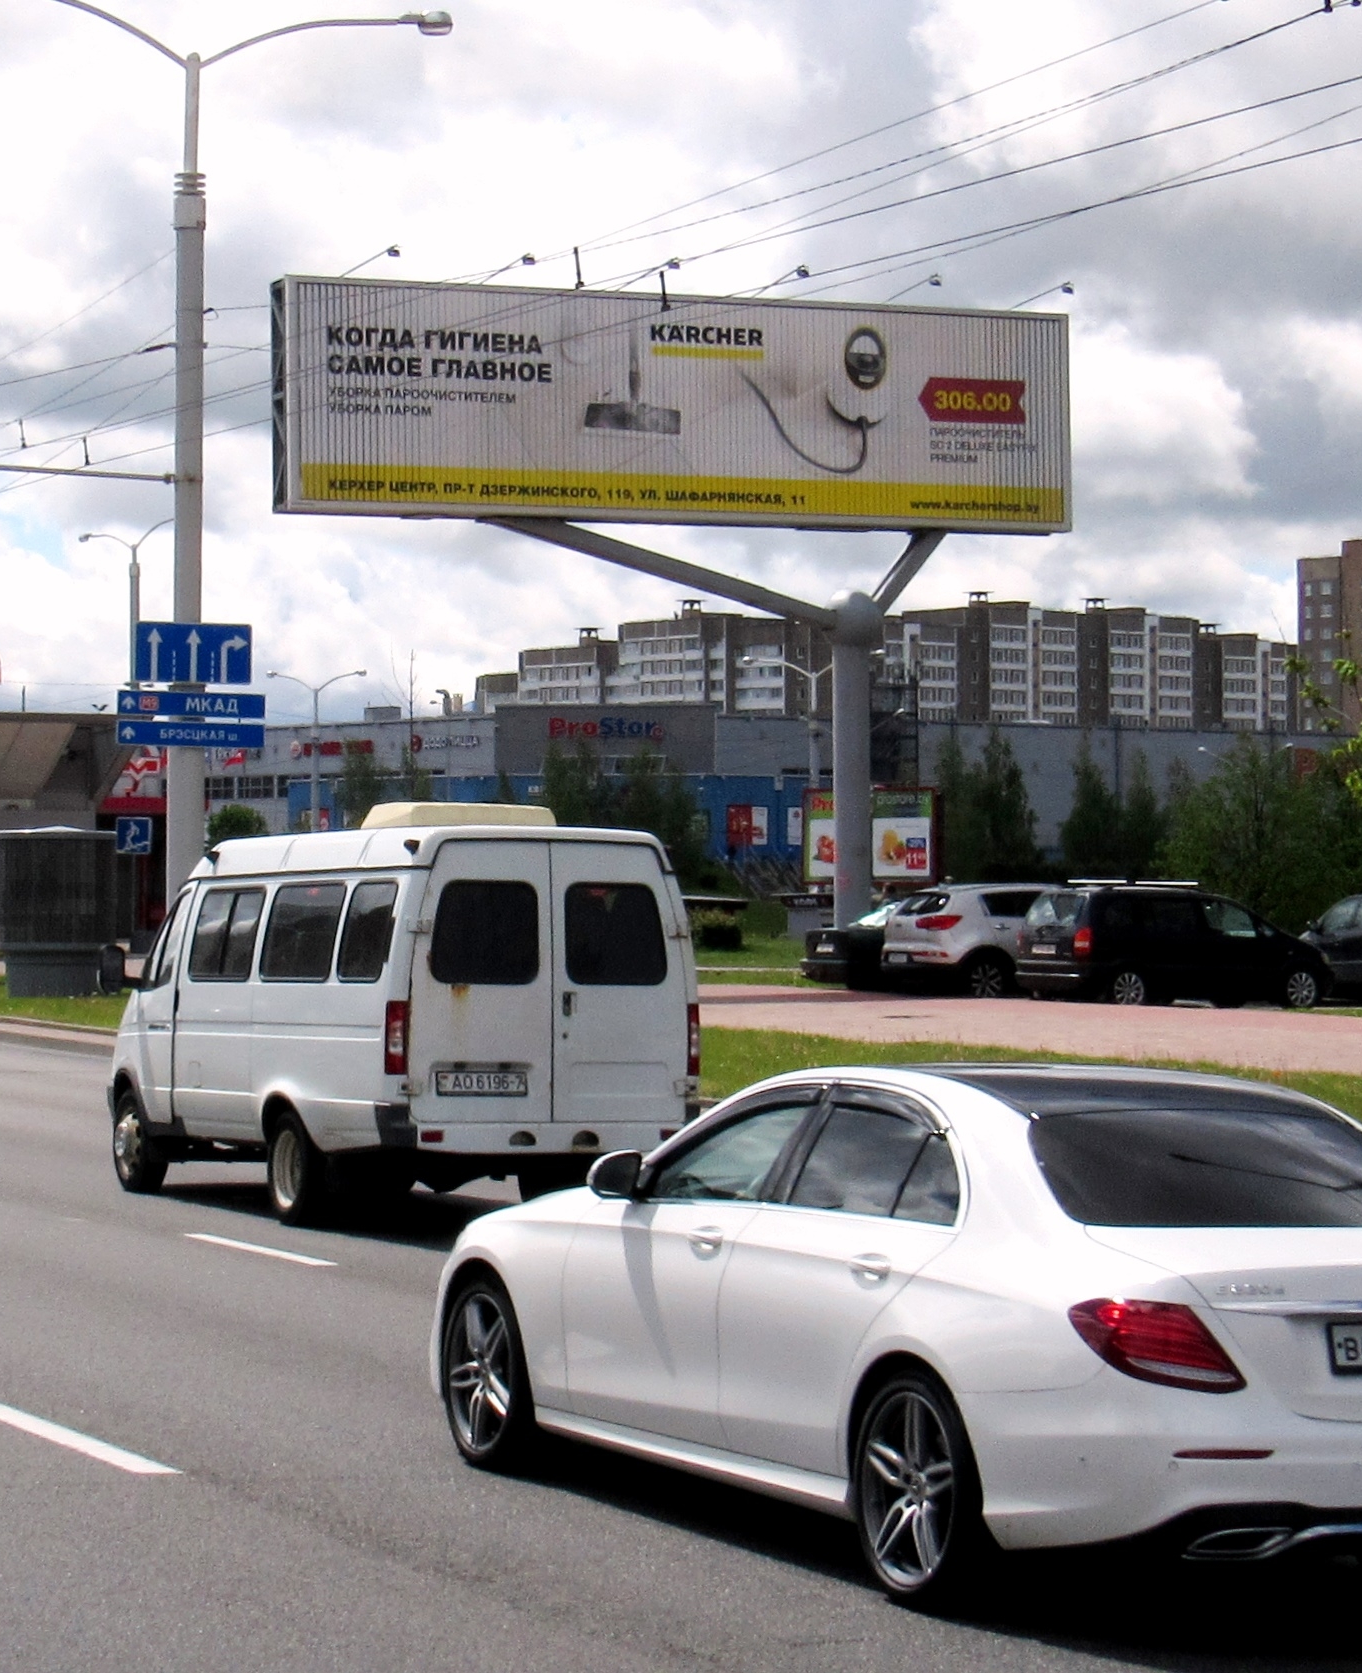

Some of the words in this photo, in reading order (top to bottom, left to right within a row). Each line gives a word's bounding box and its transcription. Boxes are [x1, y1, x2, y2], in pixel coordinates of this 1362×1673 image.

[327, 326, 415, 351] КОГДА
[424, 330, 543, 354] ГИГИЕНА
[650, 324, 763, 346] KÄRCHER
[327, 355, 422, 378] САМОЕ
[431, 358, 552, 383] ГЛАВНОЕ
[329, 387, 381, 399] УБОРКА
[934, 390, 1012, 412] 306.00
[329, 403, 381, 415] УБОРКА
[385, 405, 432, 417] ПАРОМ
[329, 480, 385, 492] КЕРХЕР
[390, 481, 438, 494] ЦЕНТР,
[444, 483, 475, 494] ПР-Т
[479, 485, 601, 500] ДЗЕРЖИНСКОГО,
[607, 489, 635, 502] 119,
[640, 490, 661, 500] УЛ.
[791, 495, 806, 505] 11
[186, 697, 239, 714] МКАД
[159, 728, 225, 741] БРЭСЦКАЯ
